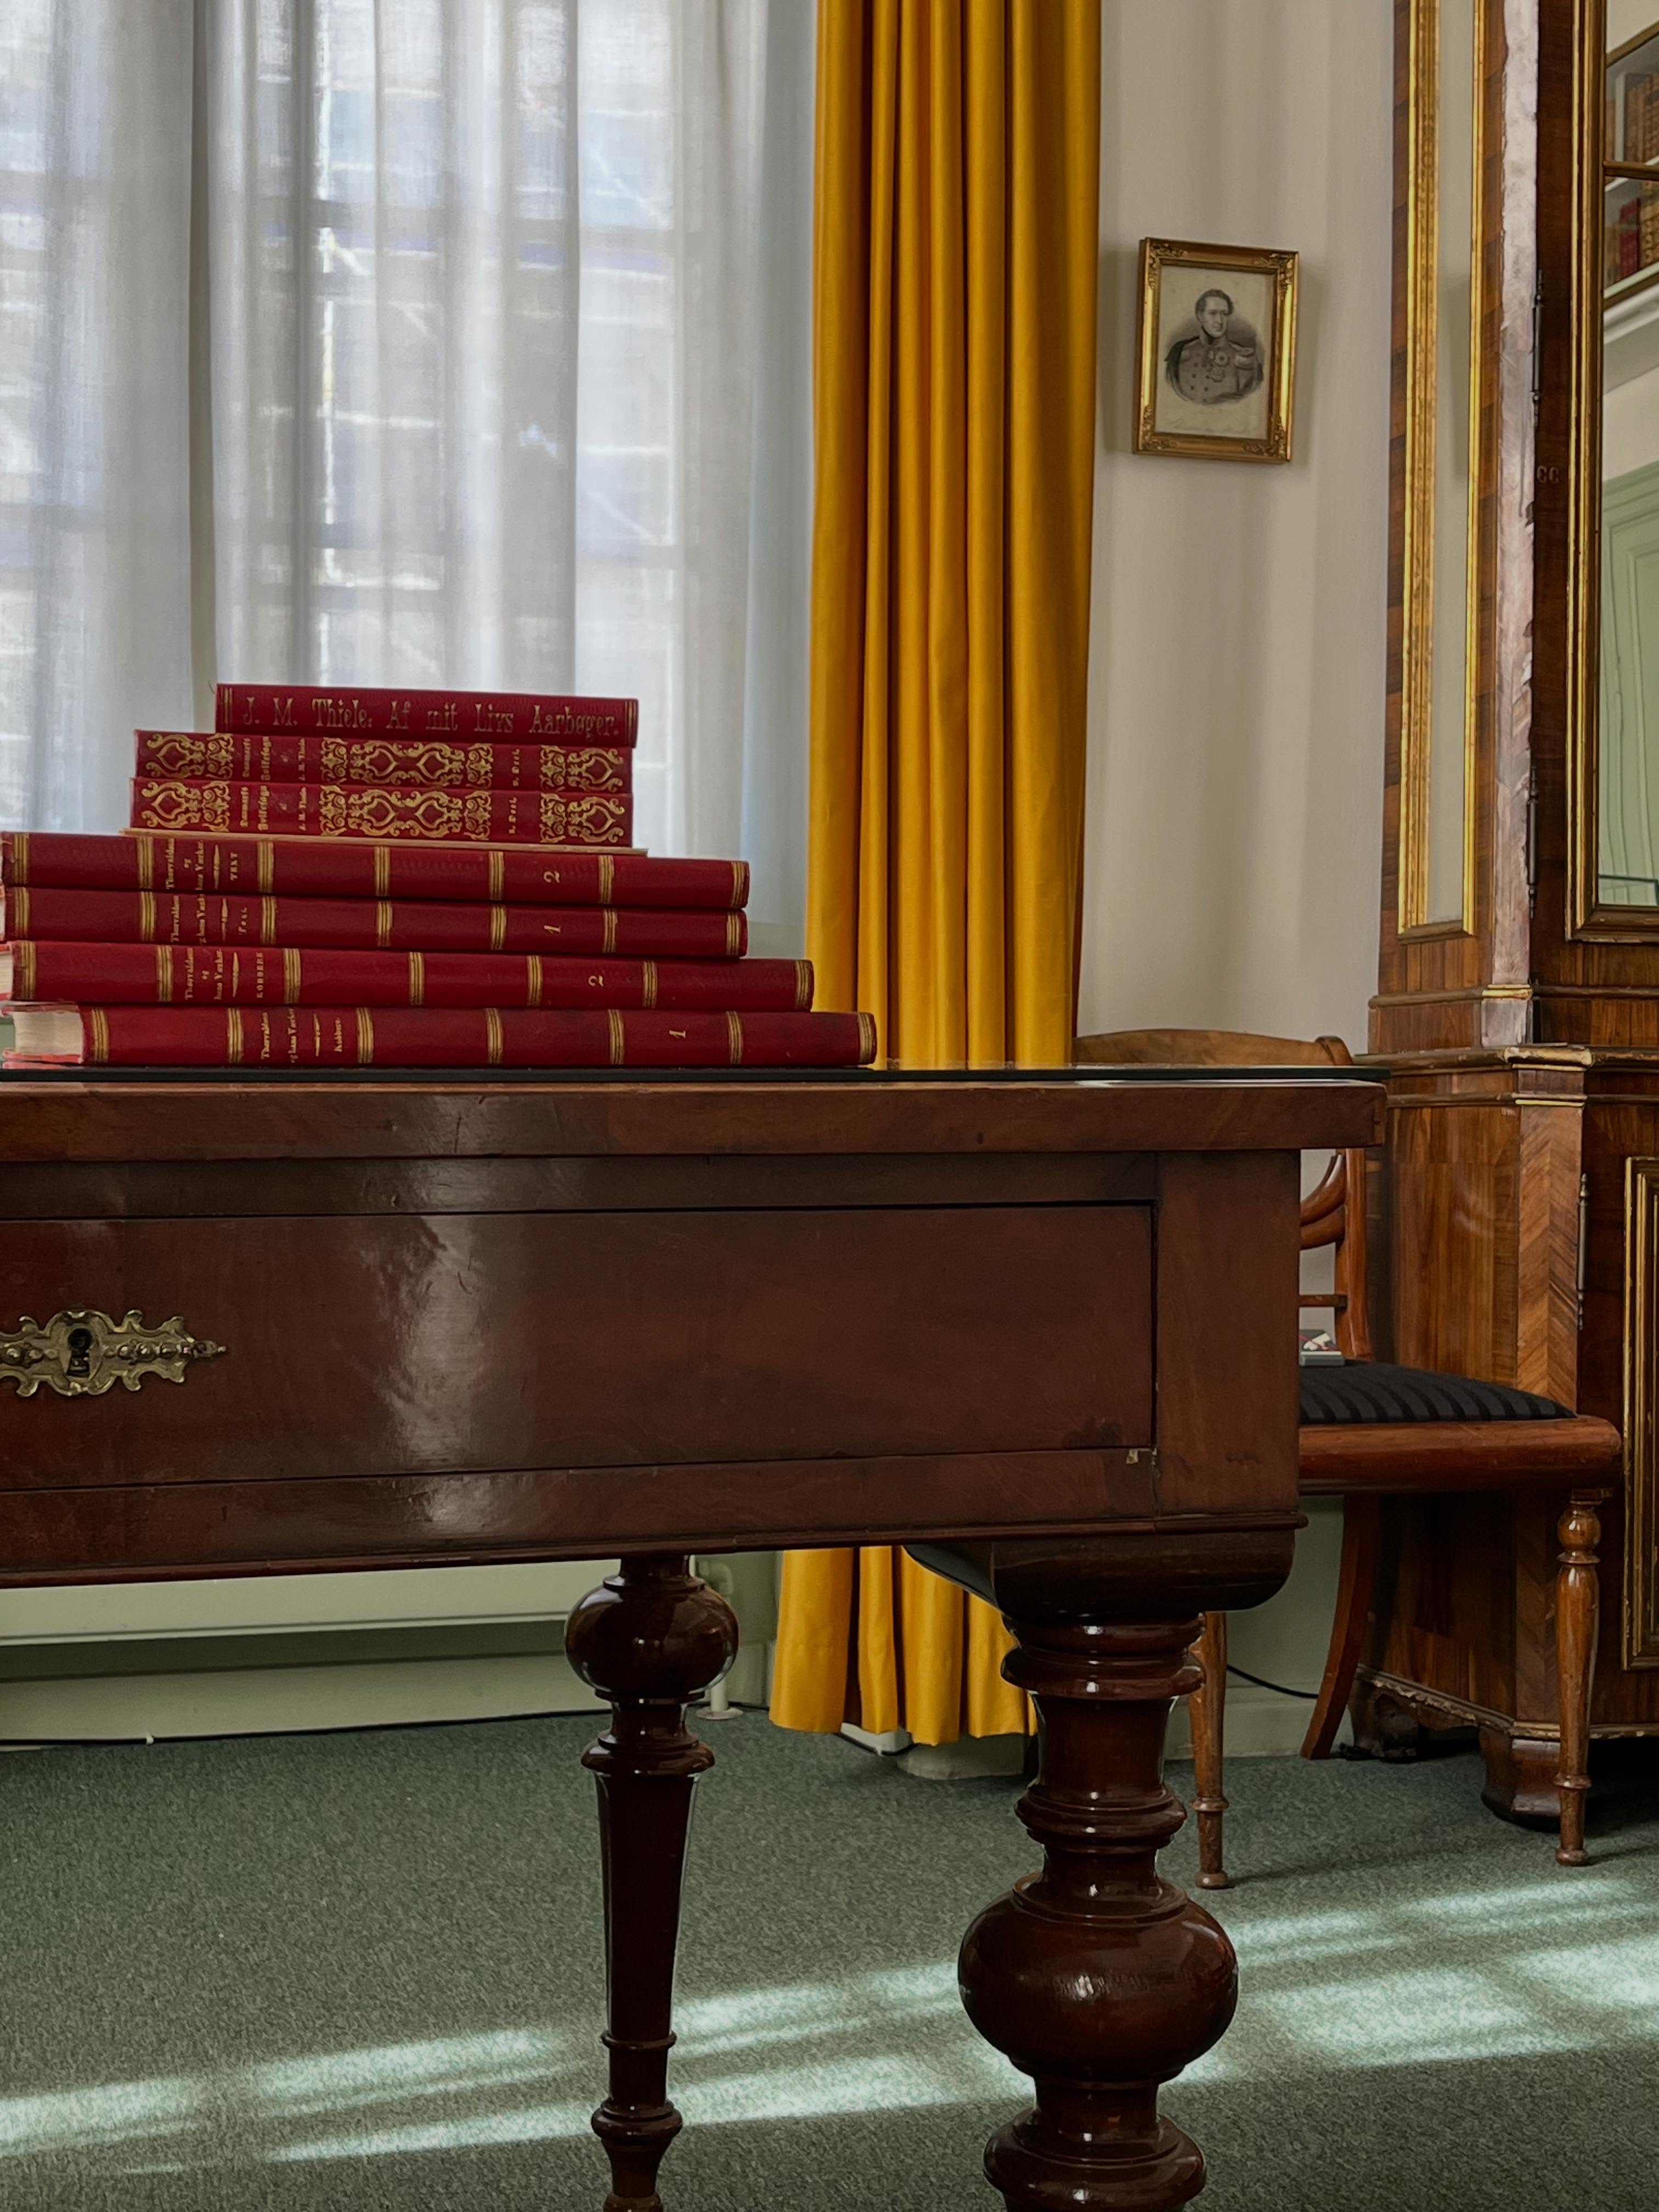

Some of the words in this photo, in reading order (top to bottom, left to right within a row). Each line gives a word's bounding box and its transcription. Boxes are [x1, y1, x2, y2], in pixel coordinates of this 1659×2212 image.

[243, 697, 260, 725] J.
[273, 697, 298, 726] M.
[386, 701, 411, 729] Af
[425, 702, 458, 731] mit
[473, 703, 514, 733] Livs
[529, 704, 619, 741] Aarbøger.
[230, 851, 238, 881] TEXT
[544, 871, 561, 883] 2
[544, 925, 561, 933] 1
[588, 975, 603, 987] 2
[668, 1030, 686, 1039] 1
